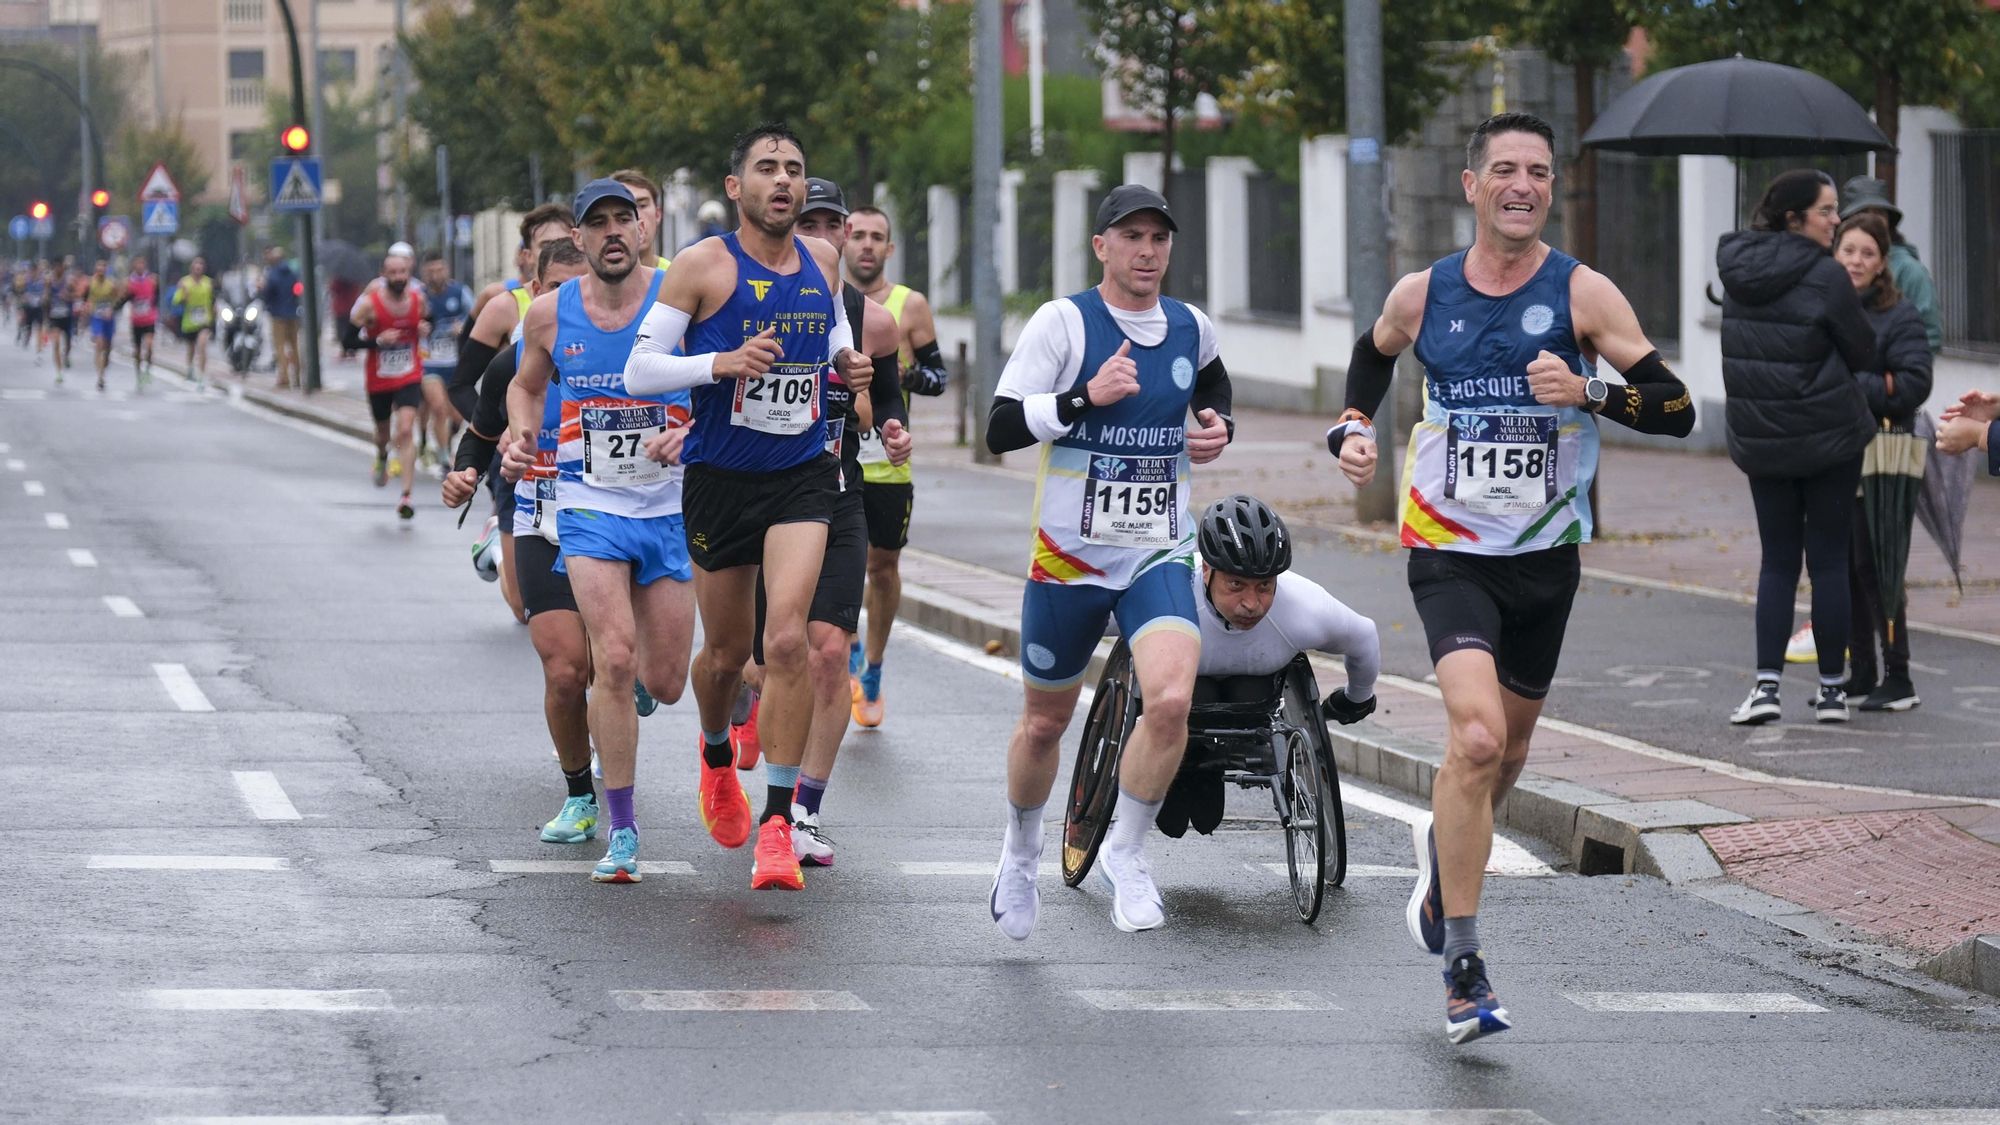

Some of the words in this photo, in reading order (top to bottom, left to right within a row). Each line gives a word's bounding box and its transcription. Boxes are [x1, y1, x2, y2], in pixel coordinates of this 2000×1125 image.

[775, 312, 792, 320] CLUB
[793, 312, 827, 320] DEPORTIVO
[743, 319, 826, 335] FUENTES
[745, 376, 813, 405] 2109
[1449, 376, 1534, 400] MOSQUE
[619, 407, 649, 418] MEDIA
[768, 409, 791, 417] CARLOS
[1500, 416, 1538, 427] MEDIA
[608, 433, 642, 459] 27
[618, 463, 635, 471] JESUS
[1137, 459, 1166, 468] MEDIA
[1460, 446, 1545, 480] 1158
[1547, 449, 1556, 479] CAJÓN
[1447, 456, 1456, 484] CAJÓN
[1490, 486, 1512, 494] ANGEL
[1097, 485, 1168, 516] 1159
[1511, 501, 1543, 509] IMDECO
[1083, 502, 1092, 530] CAJÓN
[1127, 522, 1154, 530] MANUEL
[1141, 536, 1169, 544] IMDECO
